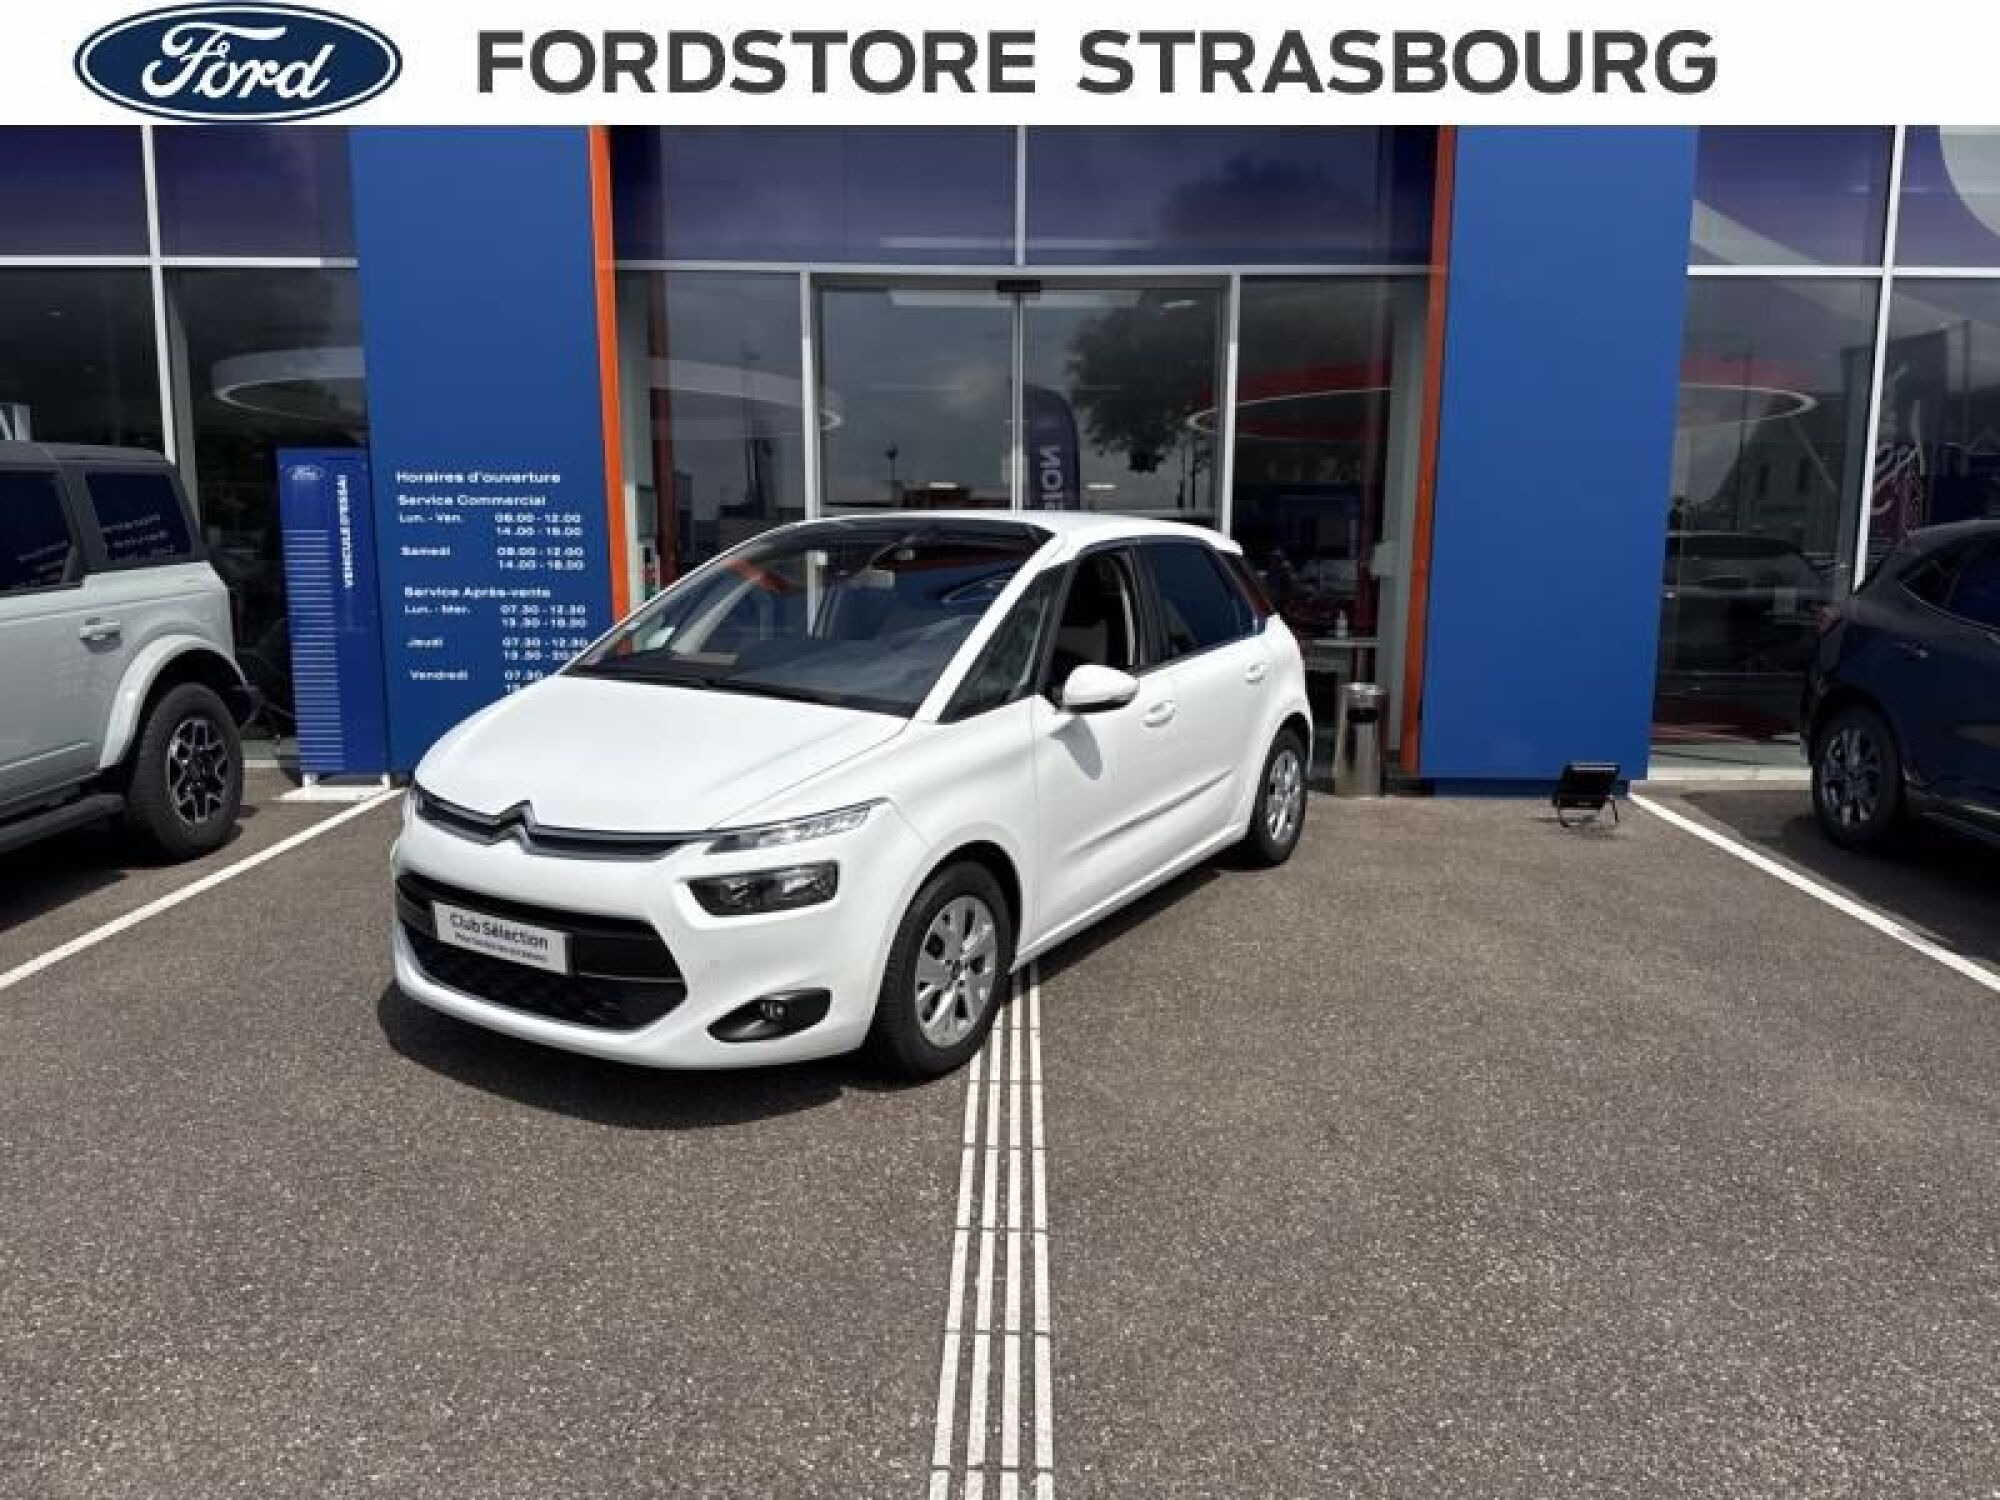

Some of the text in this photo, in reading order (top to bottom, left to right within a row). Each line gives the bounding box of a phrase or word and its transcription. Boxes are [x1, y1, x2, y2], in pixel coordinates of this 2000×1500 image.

[396, 470, 561, 484] Horaires d'ouverture
[399, 494, 546, 506] Service Commercial
[404, 586, 459, 598] Service
[449, 912, 481, 933] Club
